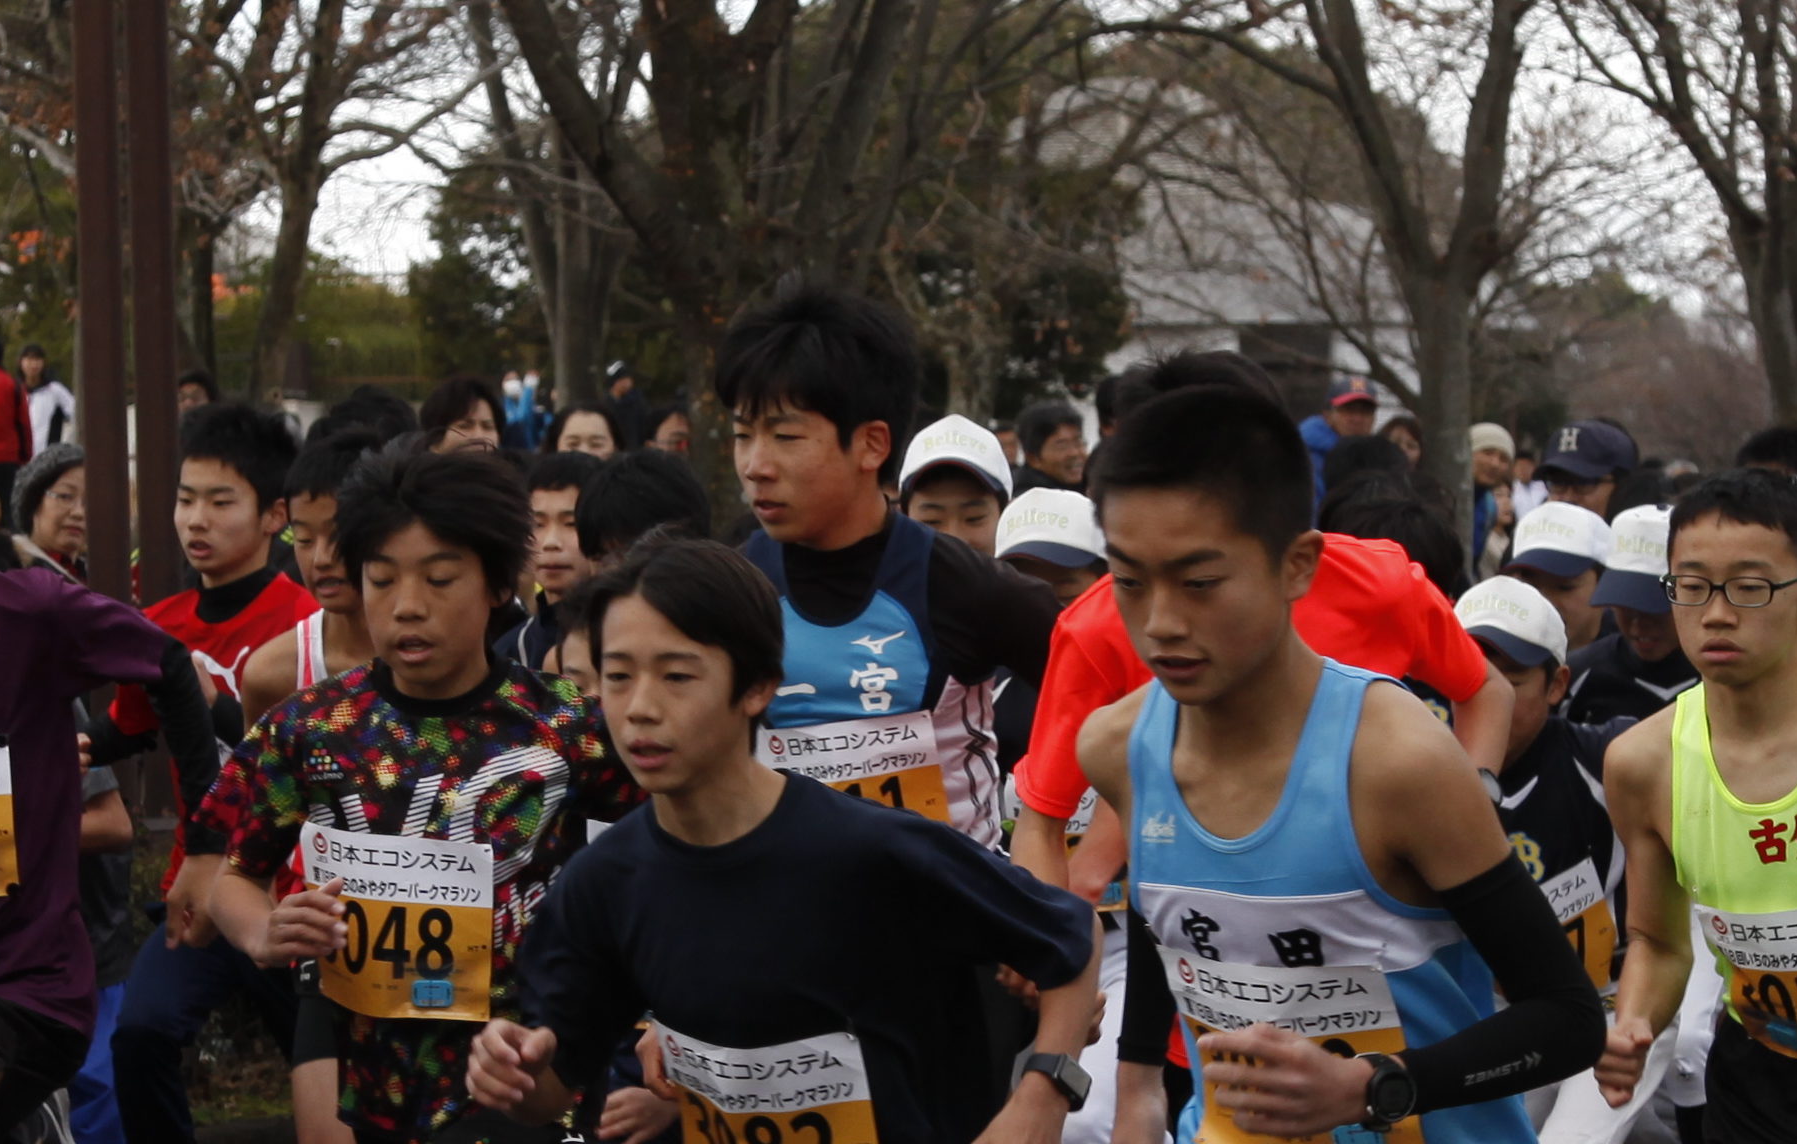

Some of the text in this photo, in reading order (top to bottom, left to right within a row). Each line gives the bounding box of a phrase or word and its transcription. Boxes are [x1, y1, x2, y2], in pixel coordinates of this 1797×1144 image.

[1558, 427, 1581, 452] H
[775, 662, 899, 712] 一宮
[787, 725, 919, 757] 日本エコシステム
[330, 840, 477, 874] 日本エコシステム
[323, 899, 454, 980] 048
[1180, 908, 1324, 968] 宮田
[1197, 968, 1368, 1004] 日本エコシステム
